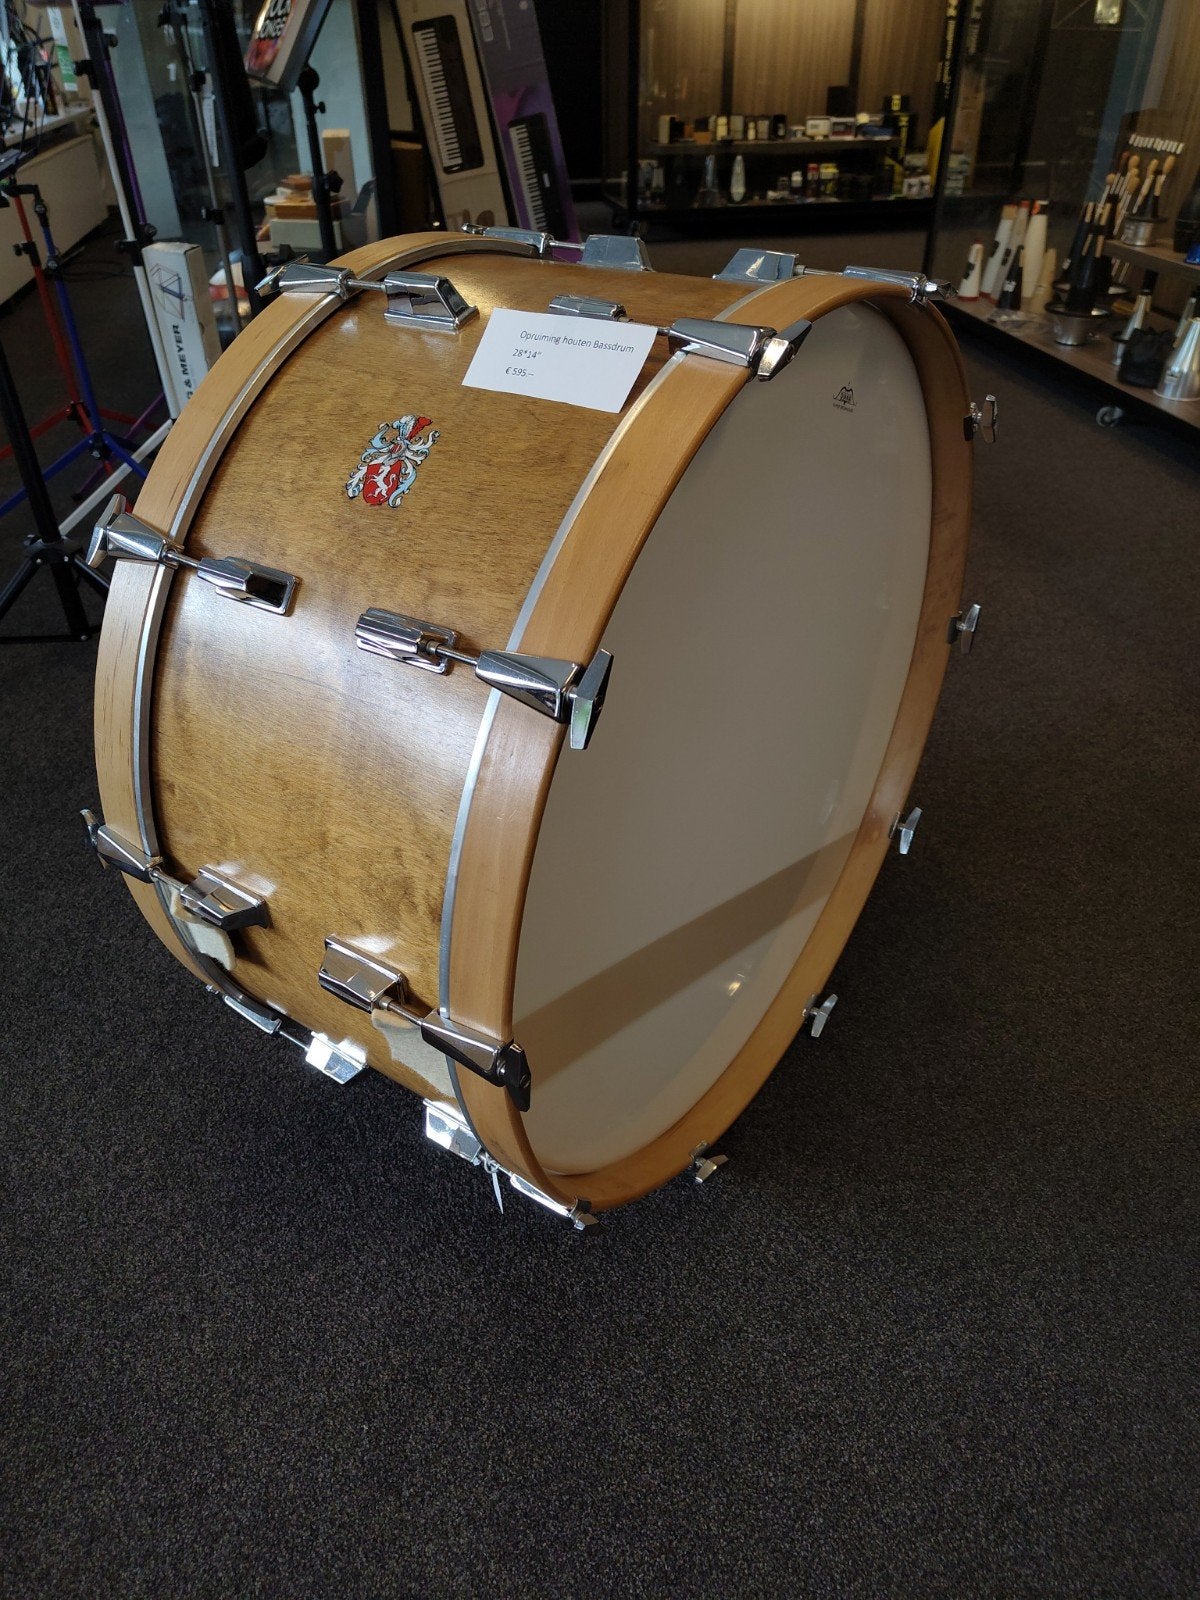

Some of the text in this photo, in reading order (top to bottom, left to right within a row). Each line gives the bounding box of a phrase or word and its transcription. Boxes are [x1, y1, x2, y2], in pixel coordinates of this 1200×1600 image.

[172, 324, 189, 375] MEYER
[519, 330, 635, 354] Opruiming houten Bassdrum
[505, 366, 511, 375] €
